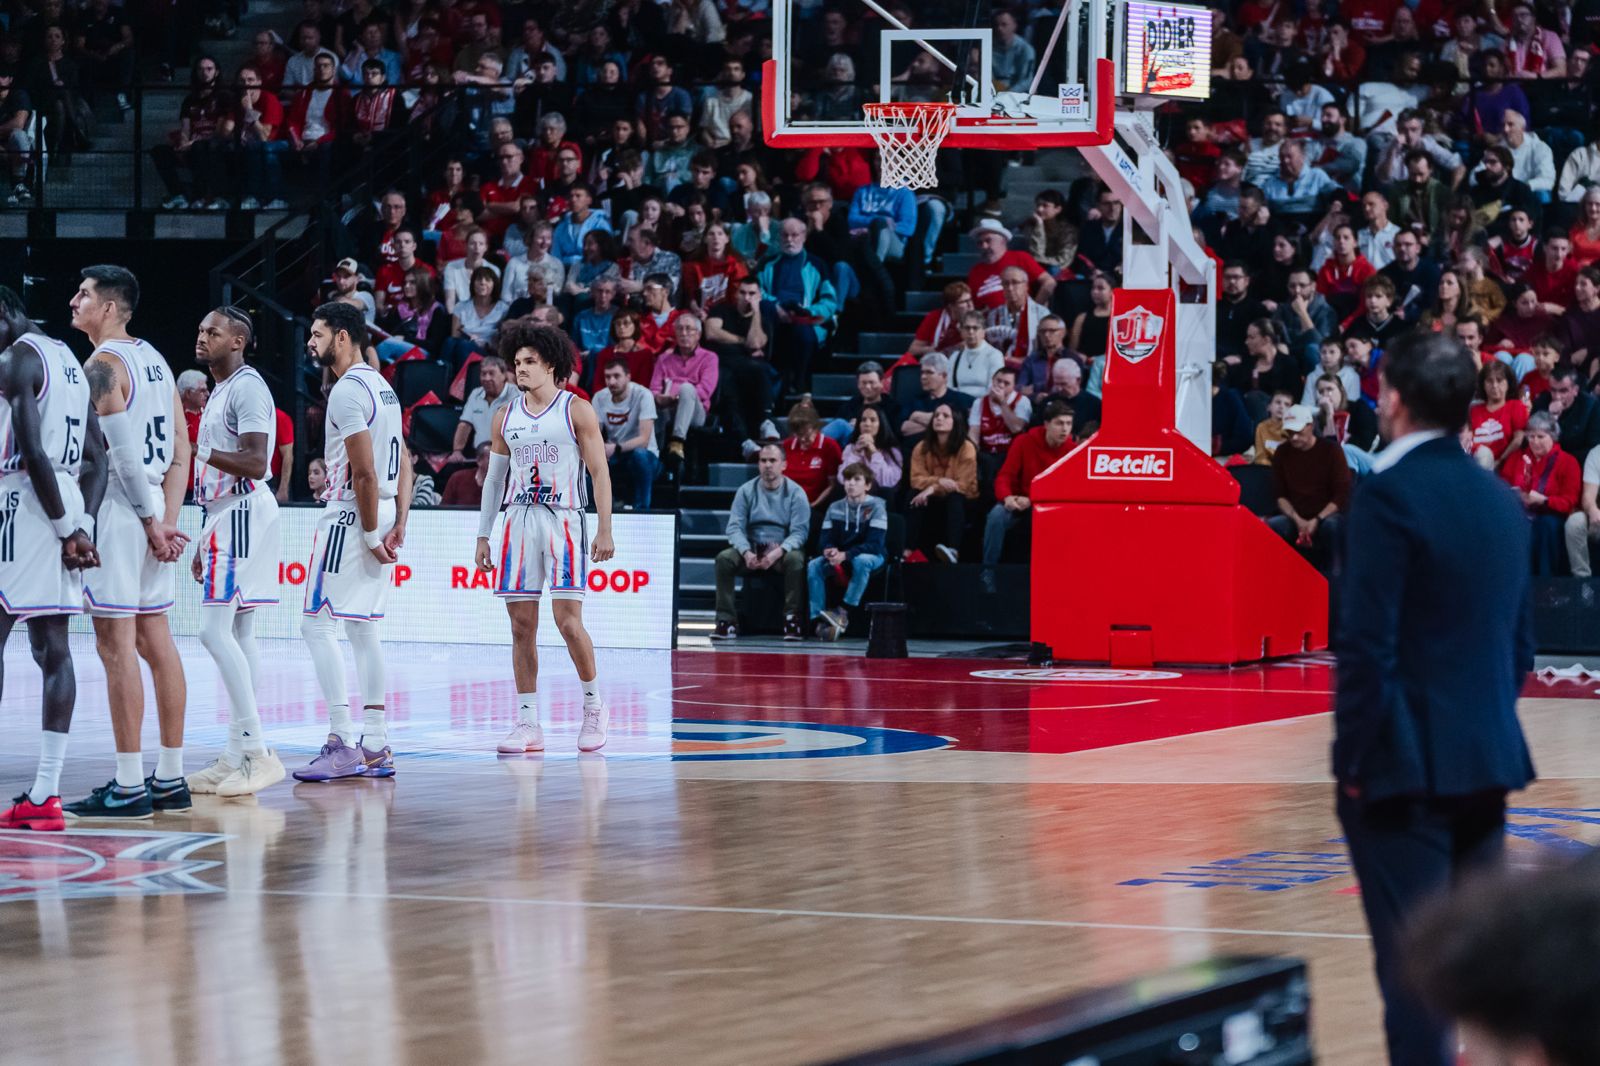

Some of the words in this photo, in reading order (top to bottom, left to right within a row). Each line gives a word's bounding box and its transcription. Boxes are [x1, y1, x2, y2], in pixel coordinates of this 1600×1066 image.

[1148, 16, 1195, 52] DIDIER
[1117, 312, 1159, 344] JL
[64, 367, 79, 384] YE
[145, 365, 163, 382] LIS
[61, 415, 80, 465] 15
[514, 443, 559, 467] PARIS
[1094, 453, 1166, 475] Betclic
[530, 466, 539, 484] 2
[338, 510, 356, 526] 20
[588, 569, 649, 593] OOP
